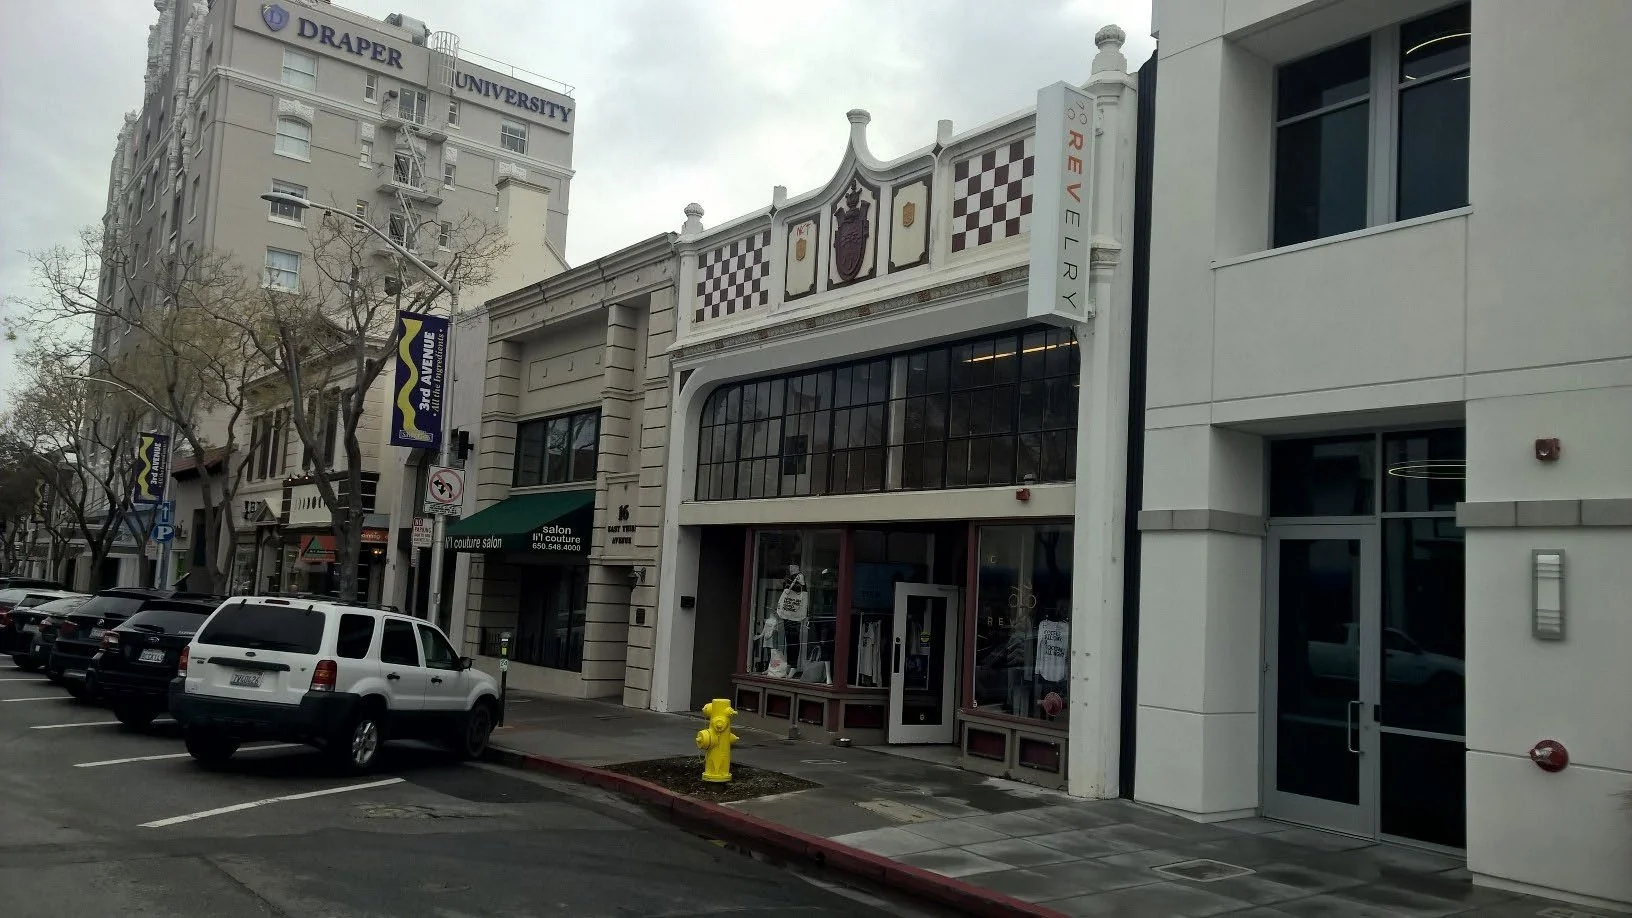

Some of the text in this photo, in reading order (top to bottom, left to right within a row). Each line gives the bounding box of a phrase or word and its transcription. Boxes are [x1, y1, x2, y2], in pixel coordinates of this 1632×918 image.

[297, 17, 404, 69] DRAPER
[454, 71, 573, 123] UNIVERSITY
[1062, 129, 1083, 309] REVELRY
[419, 331, 435, 412] 3rd AVENUE
[432, 398, 440, 412] All
[436, 333, 445, 383] Ingredients
[153, 442, 162, 471] AVENUE
[157, 526, 173, 540] P
[533, 533, 581, 543] li'l couture
[543, 525, 571, 535] salon
[608, 525, 620, 533] EAST
[454, 536, 481, 549] couture
[482, 536, 502, 549] salon
[532, 543, 581, 552] 650.548.4000
